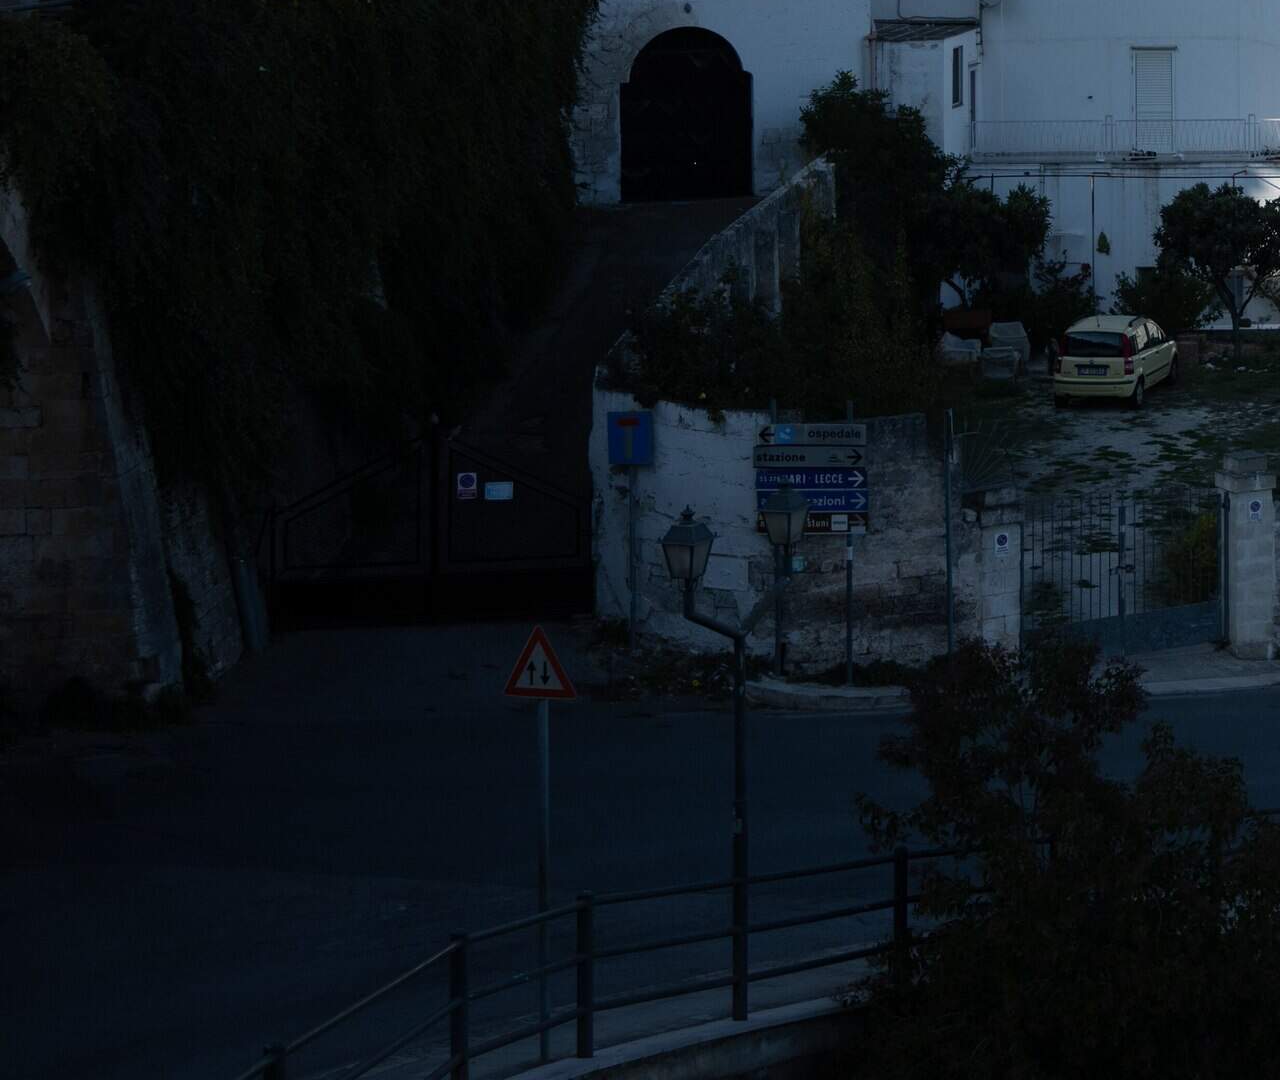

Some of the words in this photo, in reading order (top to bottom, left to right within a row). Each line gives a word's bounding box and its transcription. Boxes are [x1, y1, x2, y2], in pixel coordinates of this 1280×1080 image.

[808, 428, 861, 440] ospedale
[756, 451, 806, 463] stazione
[815, 473, 844, 484] LECCE
